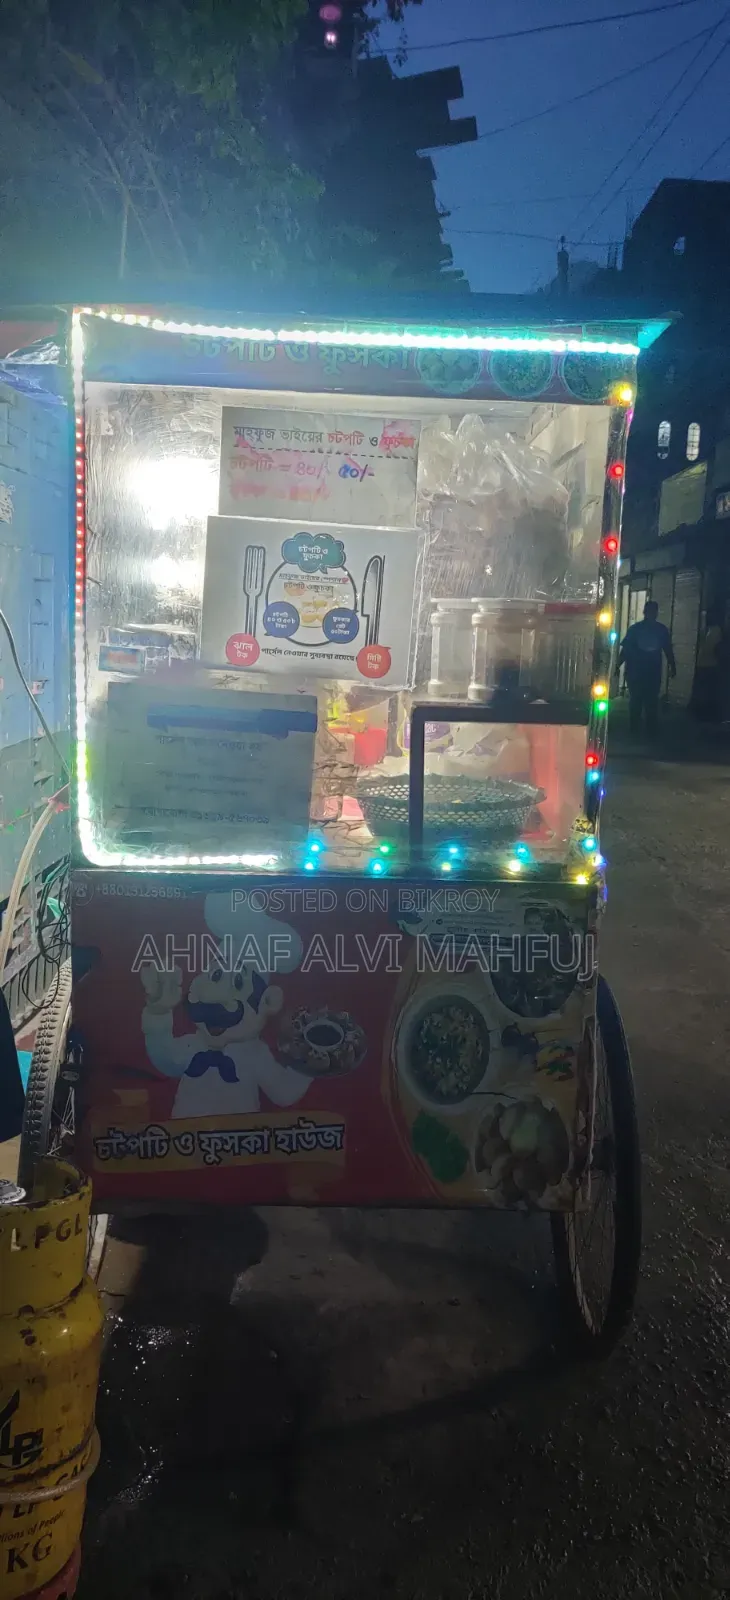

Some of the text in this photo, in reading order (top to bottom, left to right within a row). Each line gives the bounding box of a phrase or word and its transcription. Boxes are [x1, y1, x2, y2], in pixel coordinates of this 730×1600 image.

[327, 429, 365, 446] চটপটি
[369, 436, 379, 447] ও
[173, 1131, 195, 1155] ও
[198, 1127, 272, 1165] ফুসকা
[273, 1117, 346, 1152] হাউজ
[6, 1531, 54, 1573] KG
